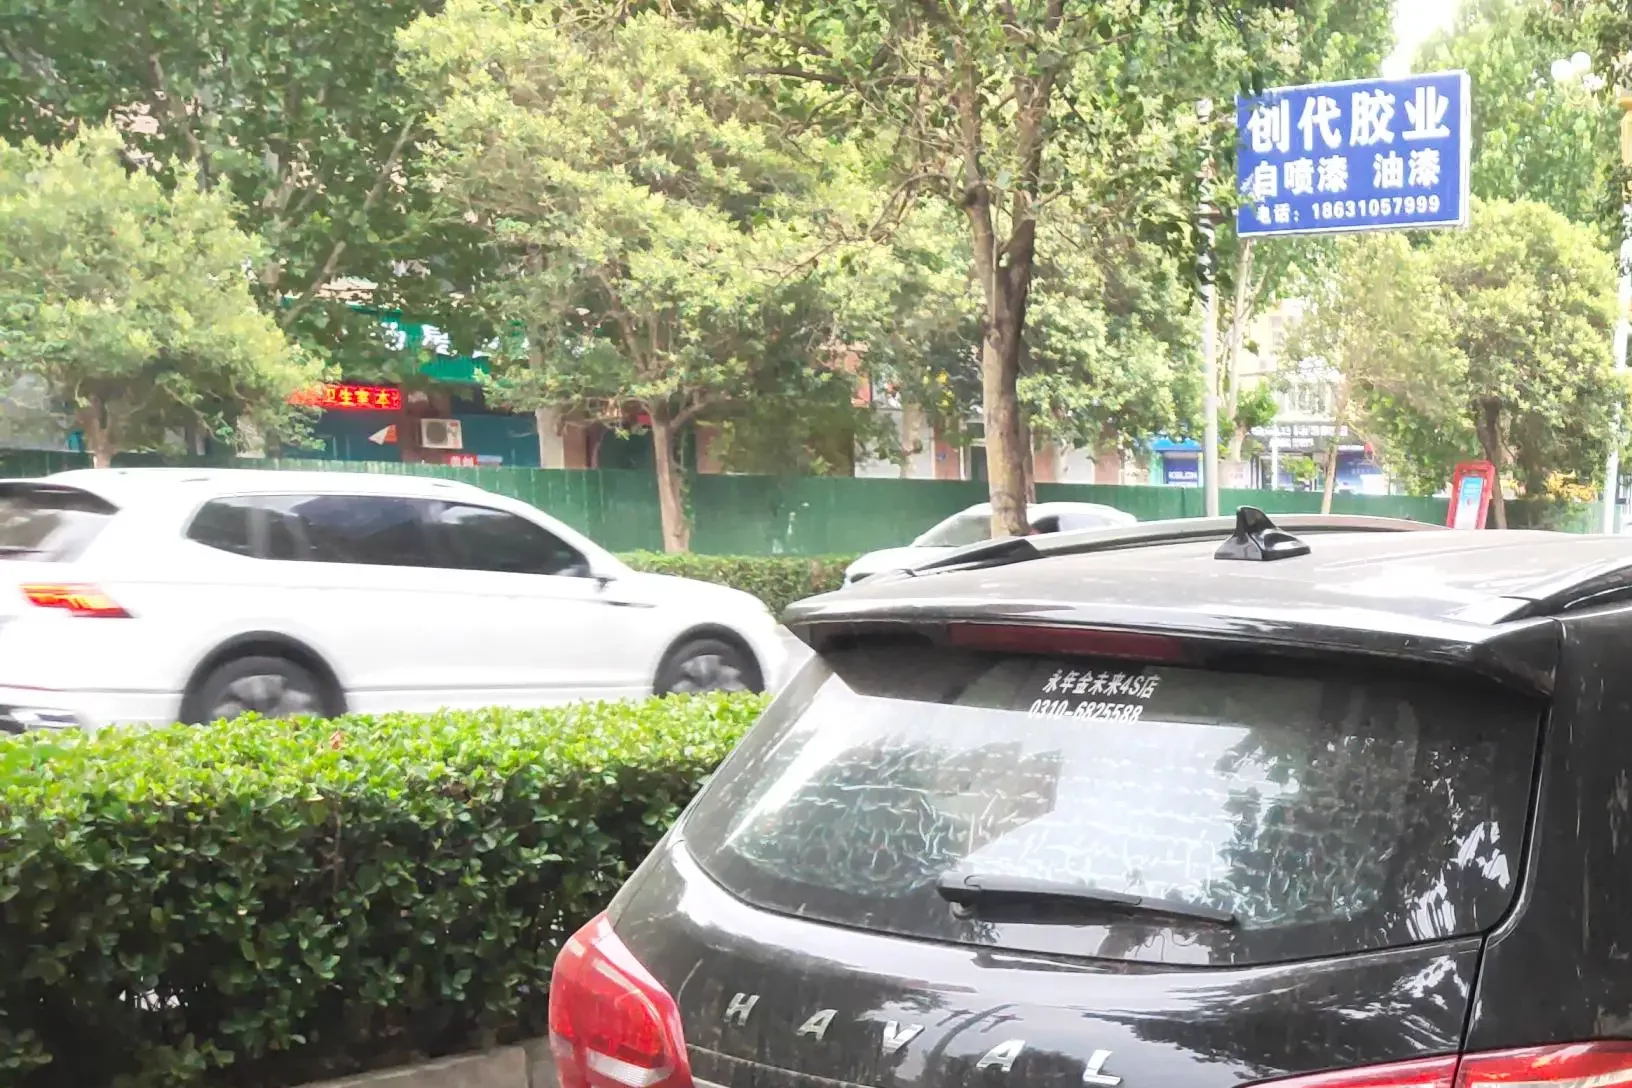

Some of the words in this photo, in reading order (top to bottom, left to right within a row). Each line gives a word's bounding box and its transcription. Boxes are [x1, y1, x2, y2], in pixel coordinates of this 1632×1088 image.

[1247, 86, 1450, 153] 创代胶业
[1252, 154, 1348, 198] 自喷漆
[1373, 147, 1440, 189] 油漆
[1312, 195, 1440, 220] 18631057999
[1028, 698, 1144, 723] 0310-6825588
[724, 992, 1122, 1087] HAVAL
